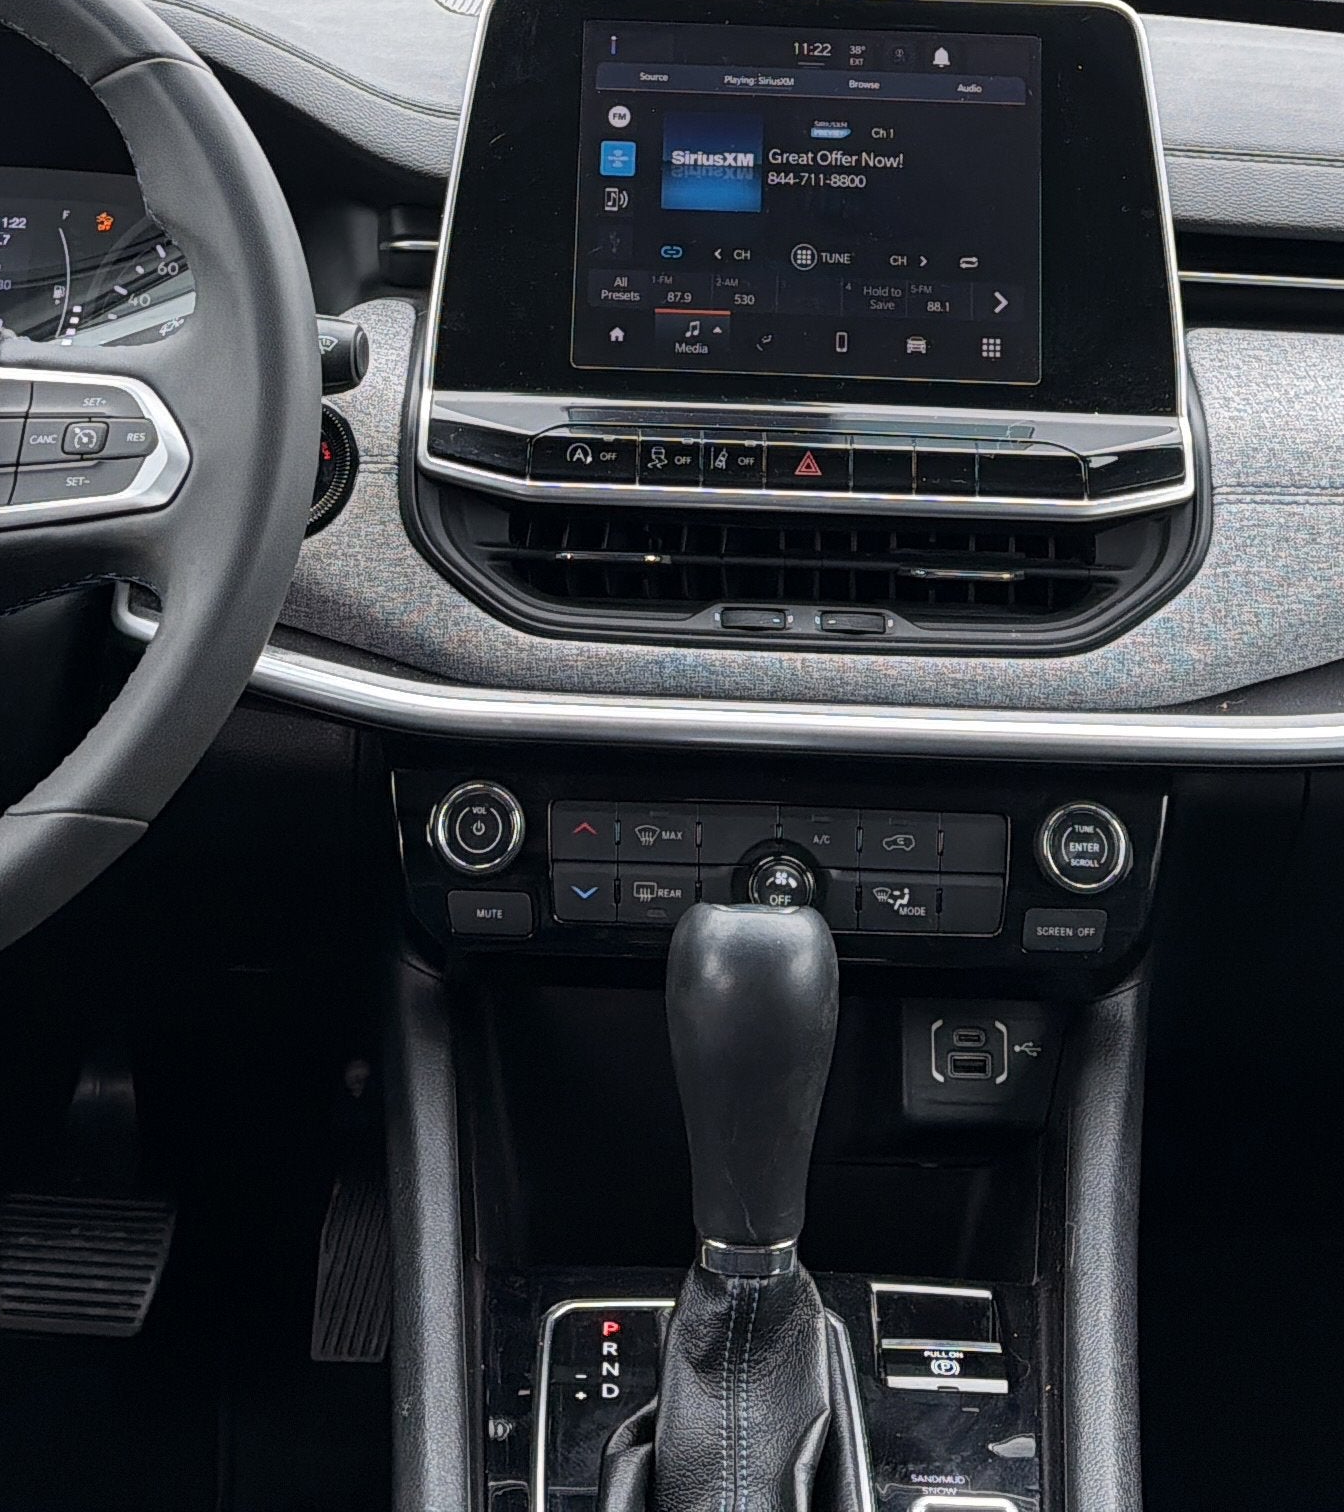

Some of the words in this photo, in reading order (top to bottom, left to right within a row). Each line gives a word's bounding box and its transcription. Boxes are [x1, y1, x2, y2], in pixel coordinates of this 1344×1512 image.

[793, 41, 833, 57] 11:22
[849, 44, 867, 56] 38°
[849, 57, 865, 67] EXT
[639, 71, 669, 82] Source
[723, 74, 757, 87] Playing:
[758, 74, 795, 87] SiriusXM
[848, 79, 881, 90] Browse
[957, 83, 983, 94] Audio
[612, 112, 627, 121] FM
[871, 127, 887, 139] Ch
[671, 150, 755, 168] SiriusXM
[768, 148, 815, 166] Great
[817, 150, 859, 167] Offer
[861, 152, 905, 169] Now!
[767, 171, 868, 189] 844-711-8800
[61, 209, 72, 220] F
[733, 249, 752, 260] CH
[821, 252, 852, 265] TUNE
[889, 255, 908, 267] CH
[157, 261, 180, 276] 60
[613, 276, 629, 288] All
[651, 275, 674, 286] 1-FM
[716, 277, 740, 288] 2-AM
[845, 282, 853, 291] 4
[600, 289, 641, 302] Presets
[863, 286, 890, 298] Hold
[890, 286, 903, 298] to
[910, 285, 933, 295] 5-FM
[126, 292, 151, 308] 40
[666, 291, 693, 304] 87.9
[733, 293, 756, 306] 530
[869, 299, 896, 311] Save
[926, 300, 951, 313] 88.1
[674, 342, 710, 355] Media
[82, 397, 107, 407] SET+
[29, 433, 59, 445] CANC
[126, 431, 147, 443] RES
[599, 452, 618, 462] OFF
[674, 455, 693, 466] OFF
[737, 456, 756, 467] OFF
[471, 806, 488, 816] VOL
[661, 831, 683, 841] MAX
[1074, 825, 1096, 835] TUNE
[813, 834, 831, 845] A/C
[1068, 842, 1101, 854] ENTER
[1069, 858, 1100, 868] SCROLL
[657, 888, 683, 899] REAR
[769, 894, 793, 907] OFF
[476, 908, 504, 920] MUTE
[898, 905, 927, 917] MODE
[1036, 926, 1074, 938] SCREEN
[1076, 927, 1097, 938] OFF
[602, 1320, 621, 1337] P
[601, 1341, 619, 1356] R
[923, 1350, 949, 1359] PULL
[948, 1351, 965, 1360] ON
[601, 1361, 621, 1377] N
[601, 1382, 621, 1400] D
[910, 1473, 967, 1486] SAND/MUD
[921, 1486, 958, 1496] SNOW
